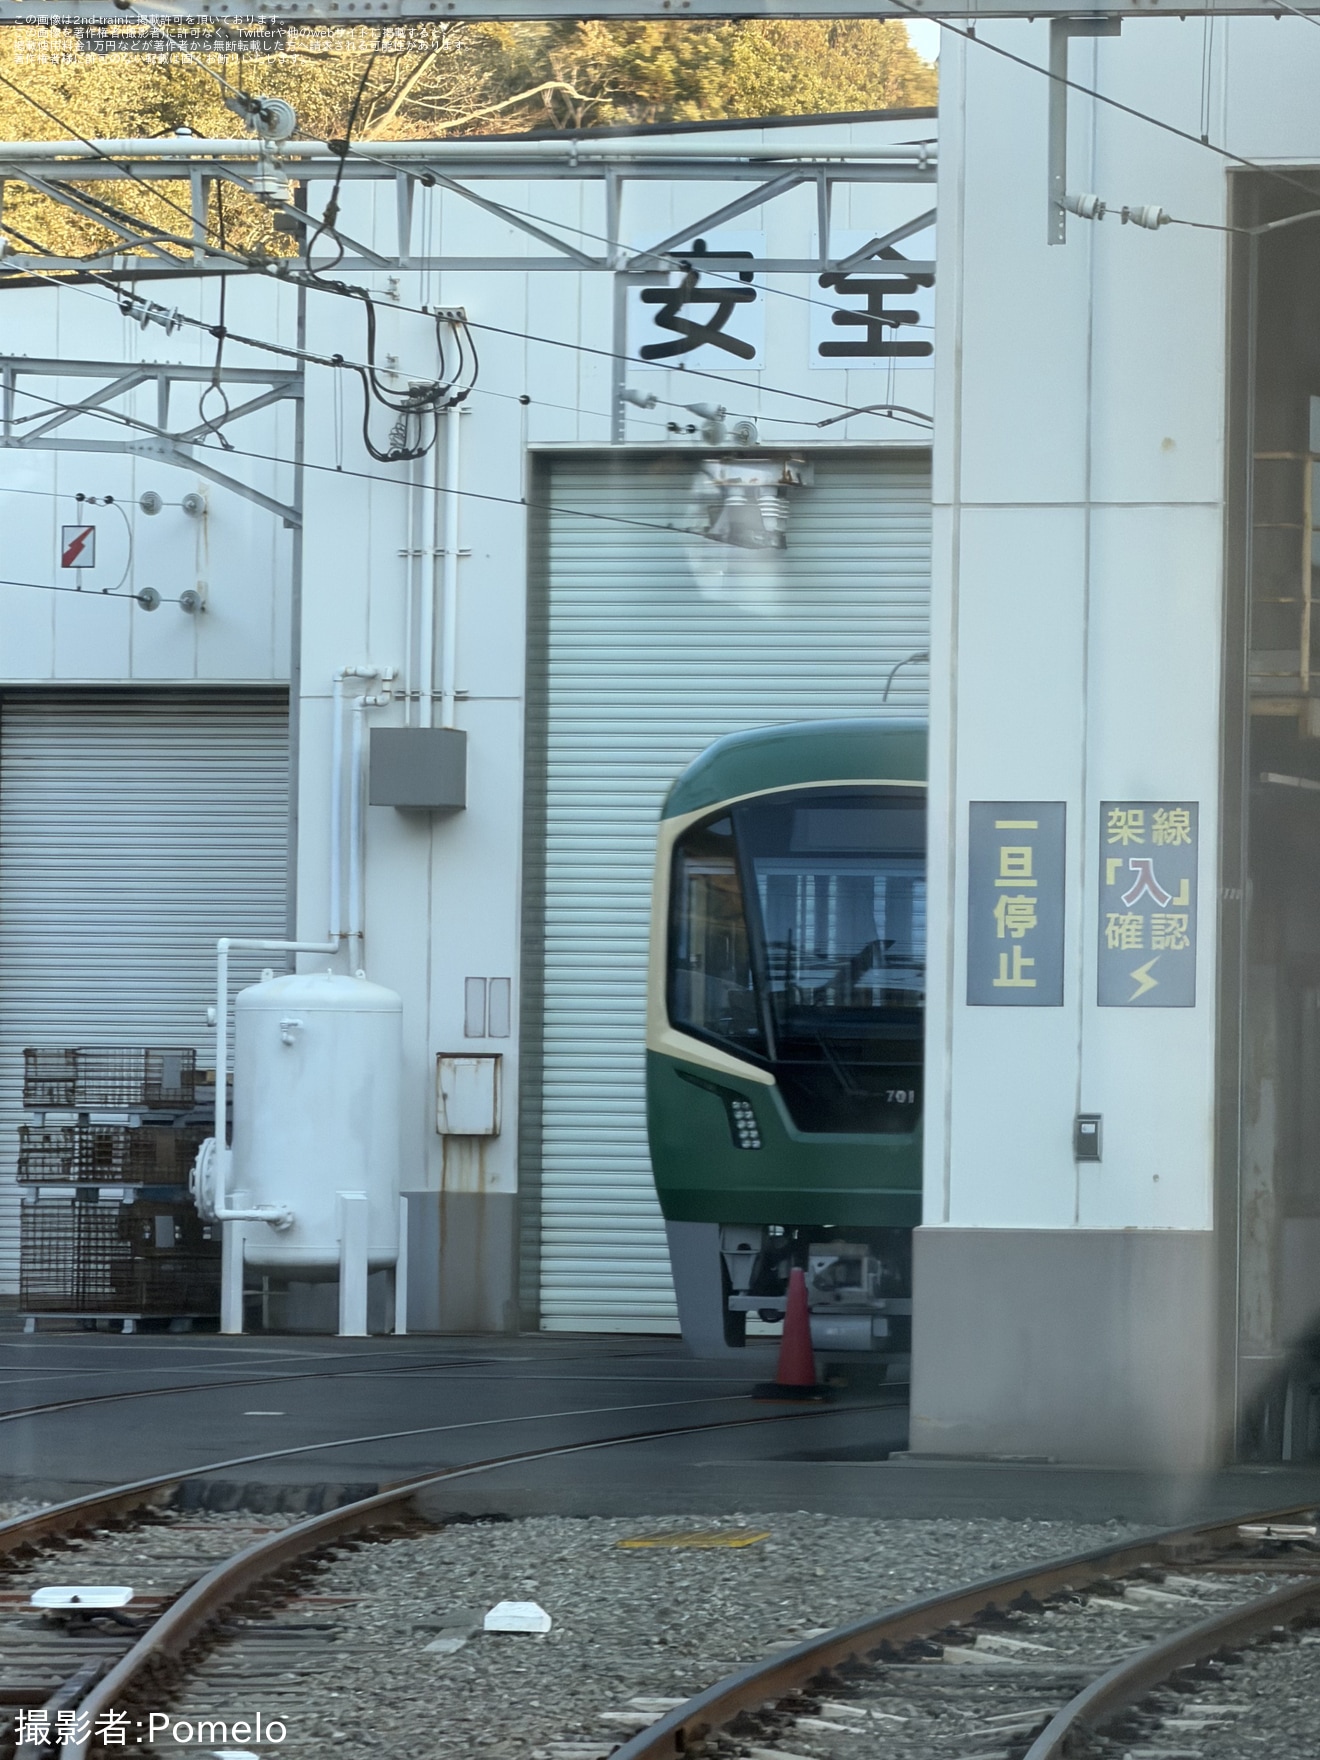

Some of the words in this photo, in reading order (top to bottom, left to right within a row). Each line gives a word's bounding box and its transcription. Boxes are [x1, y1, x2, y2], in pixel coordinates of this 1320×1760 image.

[1107, 807, 1192, 846] 架線
[993, 820, 1039, 987] 一旦停止
[1105, 912, 1190, 950] 確認
